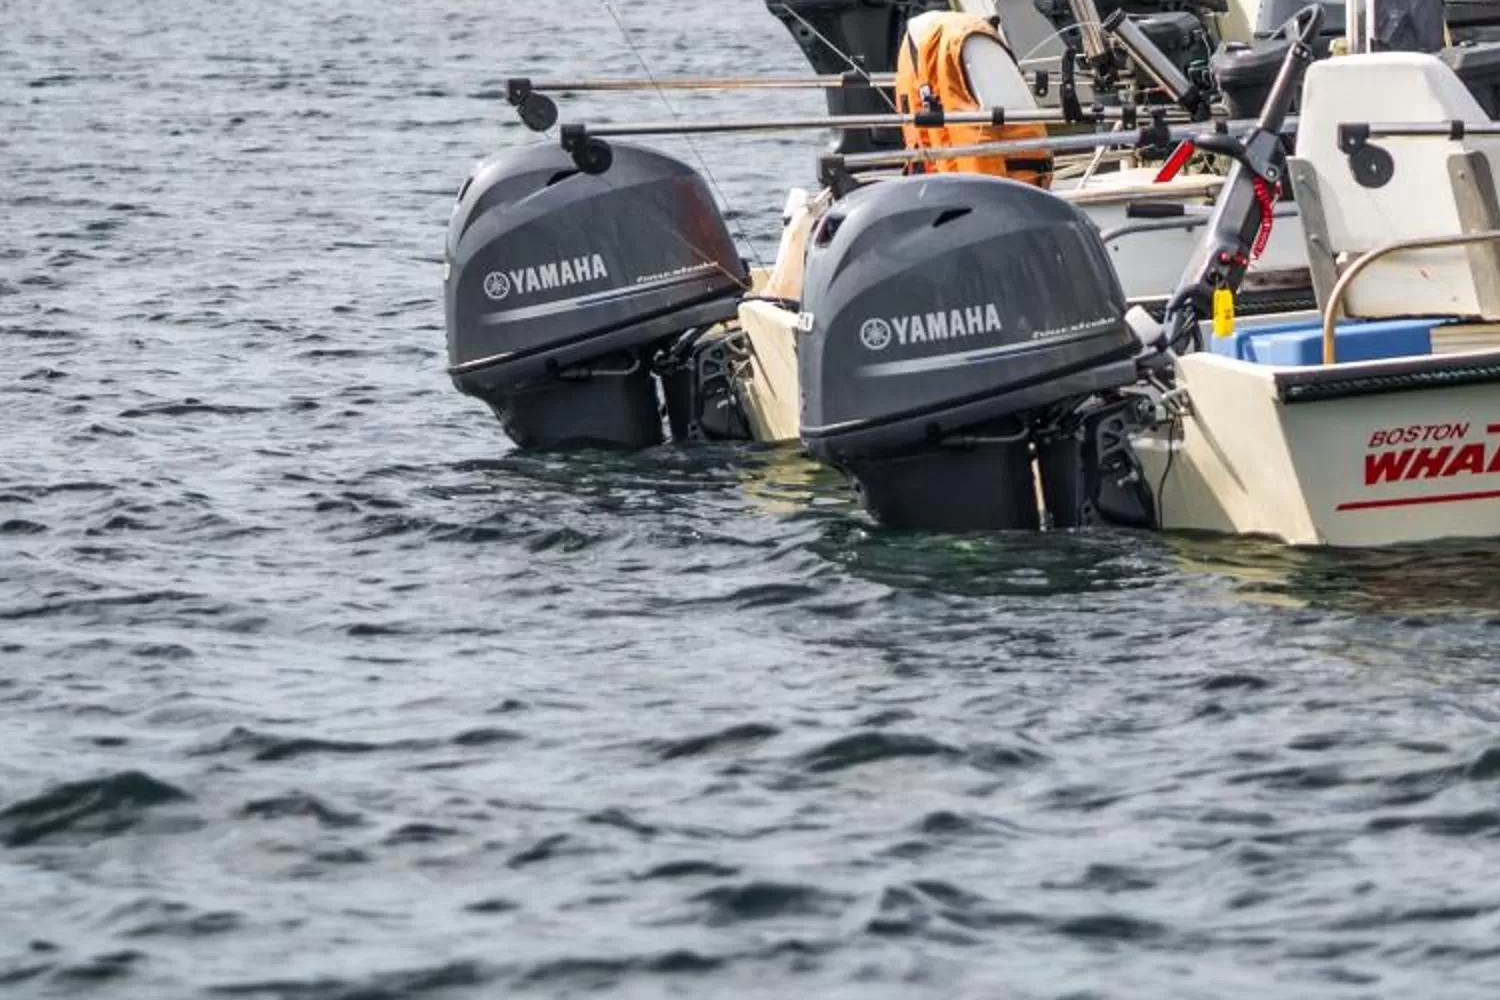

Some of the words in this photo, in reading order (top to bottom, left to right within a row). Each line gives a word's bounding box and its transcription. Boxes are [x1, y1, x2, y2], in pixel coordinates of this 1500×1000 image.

[509, 253, 609, 295] YAMAHA
[892, 303, 1002, 345] YAMAHA
[1368, 421, 1471, 449] BOSTON
